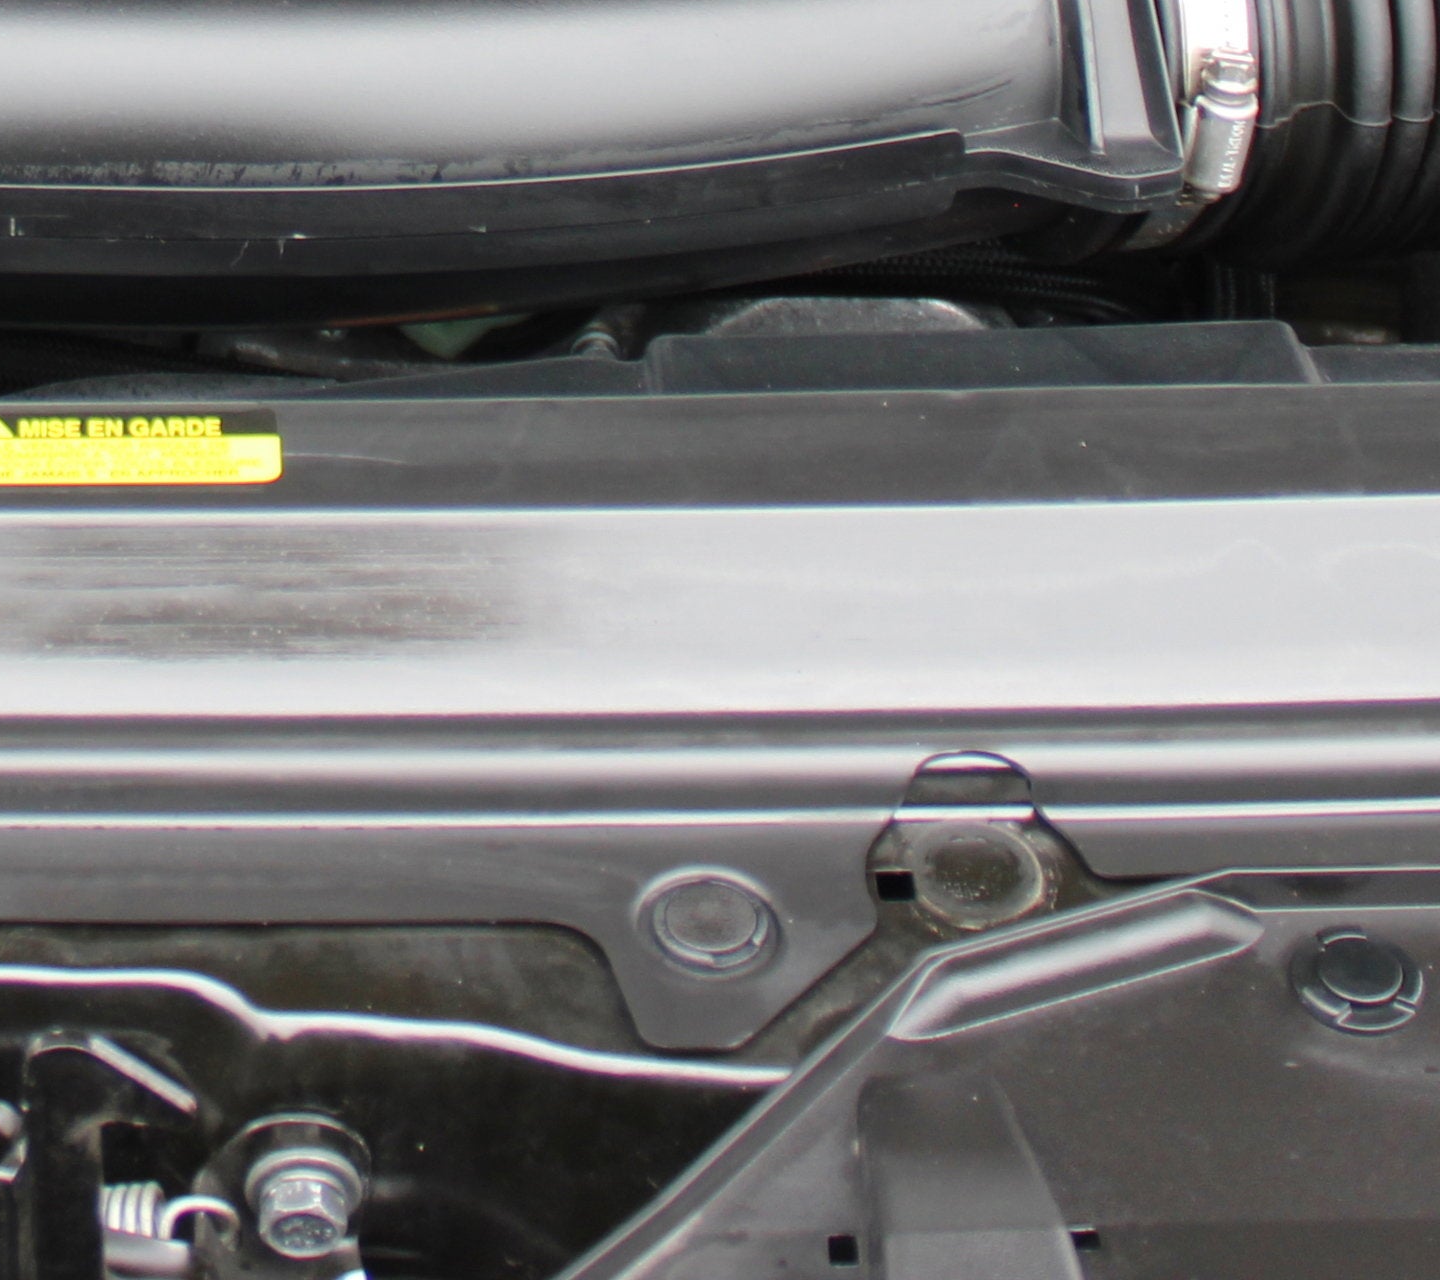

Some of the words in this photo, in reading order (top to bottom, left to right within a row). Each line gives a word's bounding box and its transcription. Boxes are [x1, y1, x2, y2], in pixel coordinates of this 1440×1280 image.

[17, 417, 81, 438] MISE
[86, 417, 124, 438] EN
[128, 417, 222, 438] GARDE
